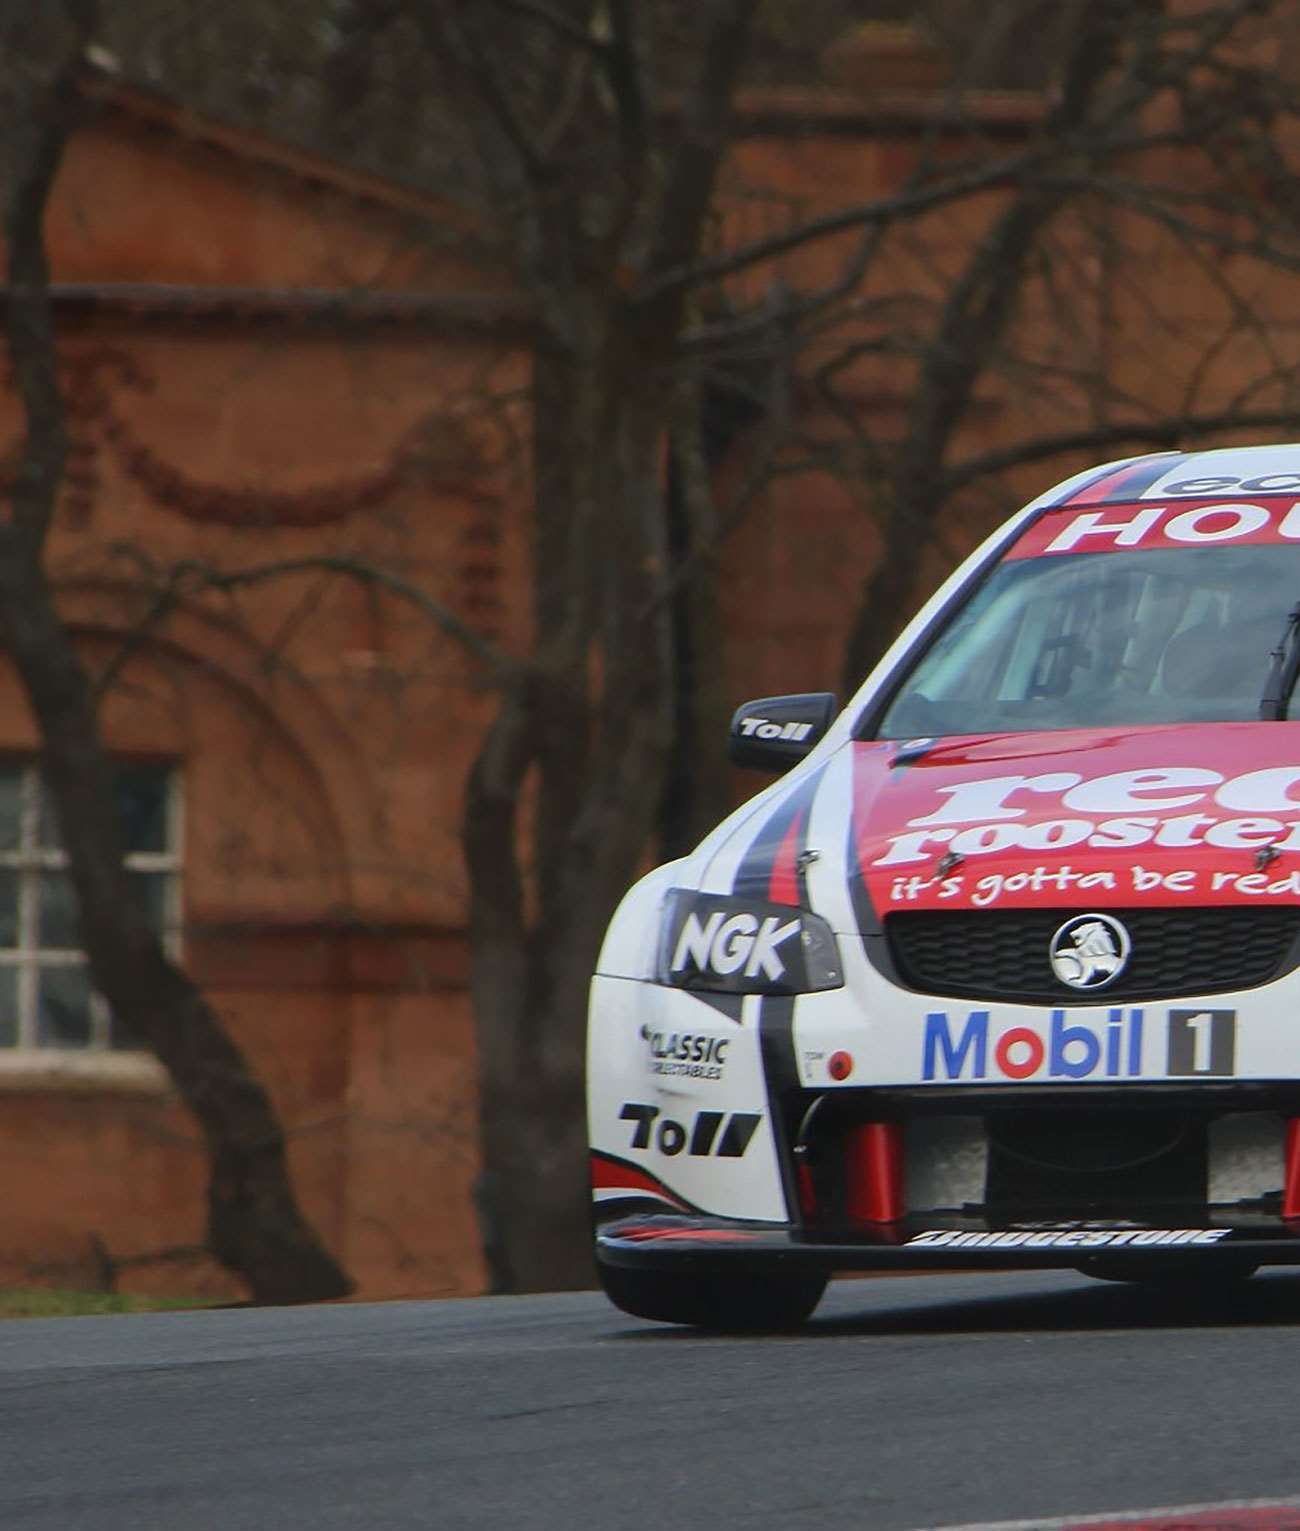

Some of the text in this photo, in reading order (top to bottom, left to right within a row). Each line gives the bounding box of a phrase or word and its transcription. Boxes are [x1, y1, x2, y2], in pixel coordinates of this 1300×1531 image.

[741, 717, 814, 742] Toll
[890, 873, 964, 900] it's
[970, 866, 1117, 906] gotta
[1132, 865, 1197, 892] be
[671, 911, 799, 983] NGK
[920, 1007, 1145, 1081] Mobil
[618, 1103, 764, 1158] Toll
